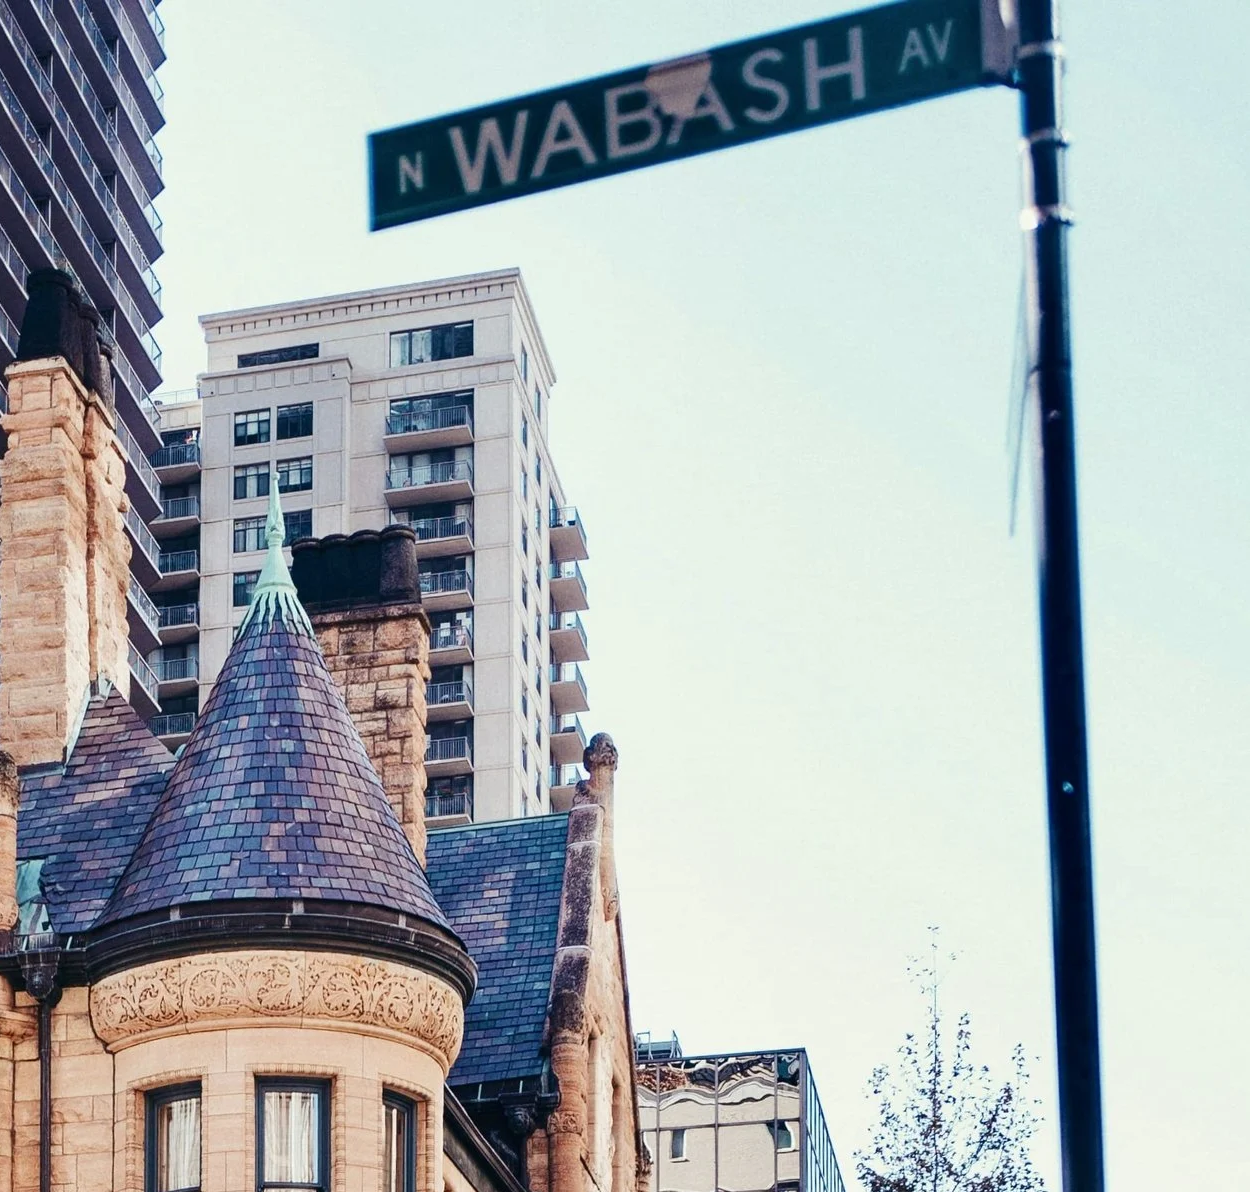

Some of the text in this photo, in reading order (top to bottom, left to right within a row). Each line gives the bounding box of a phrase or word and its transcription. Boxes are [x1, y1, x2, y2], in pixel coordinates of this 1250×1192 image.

[397, 19, 954, 194] N WABASH AV
